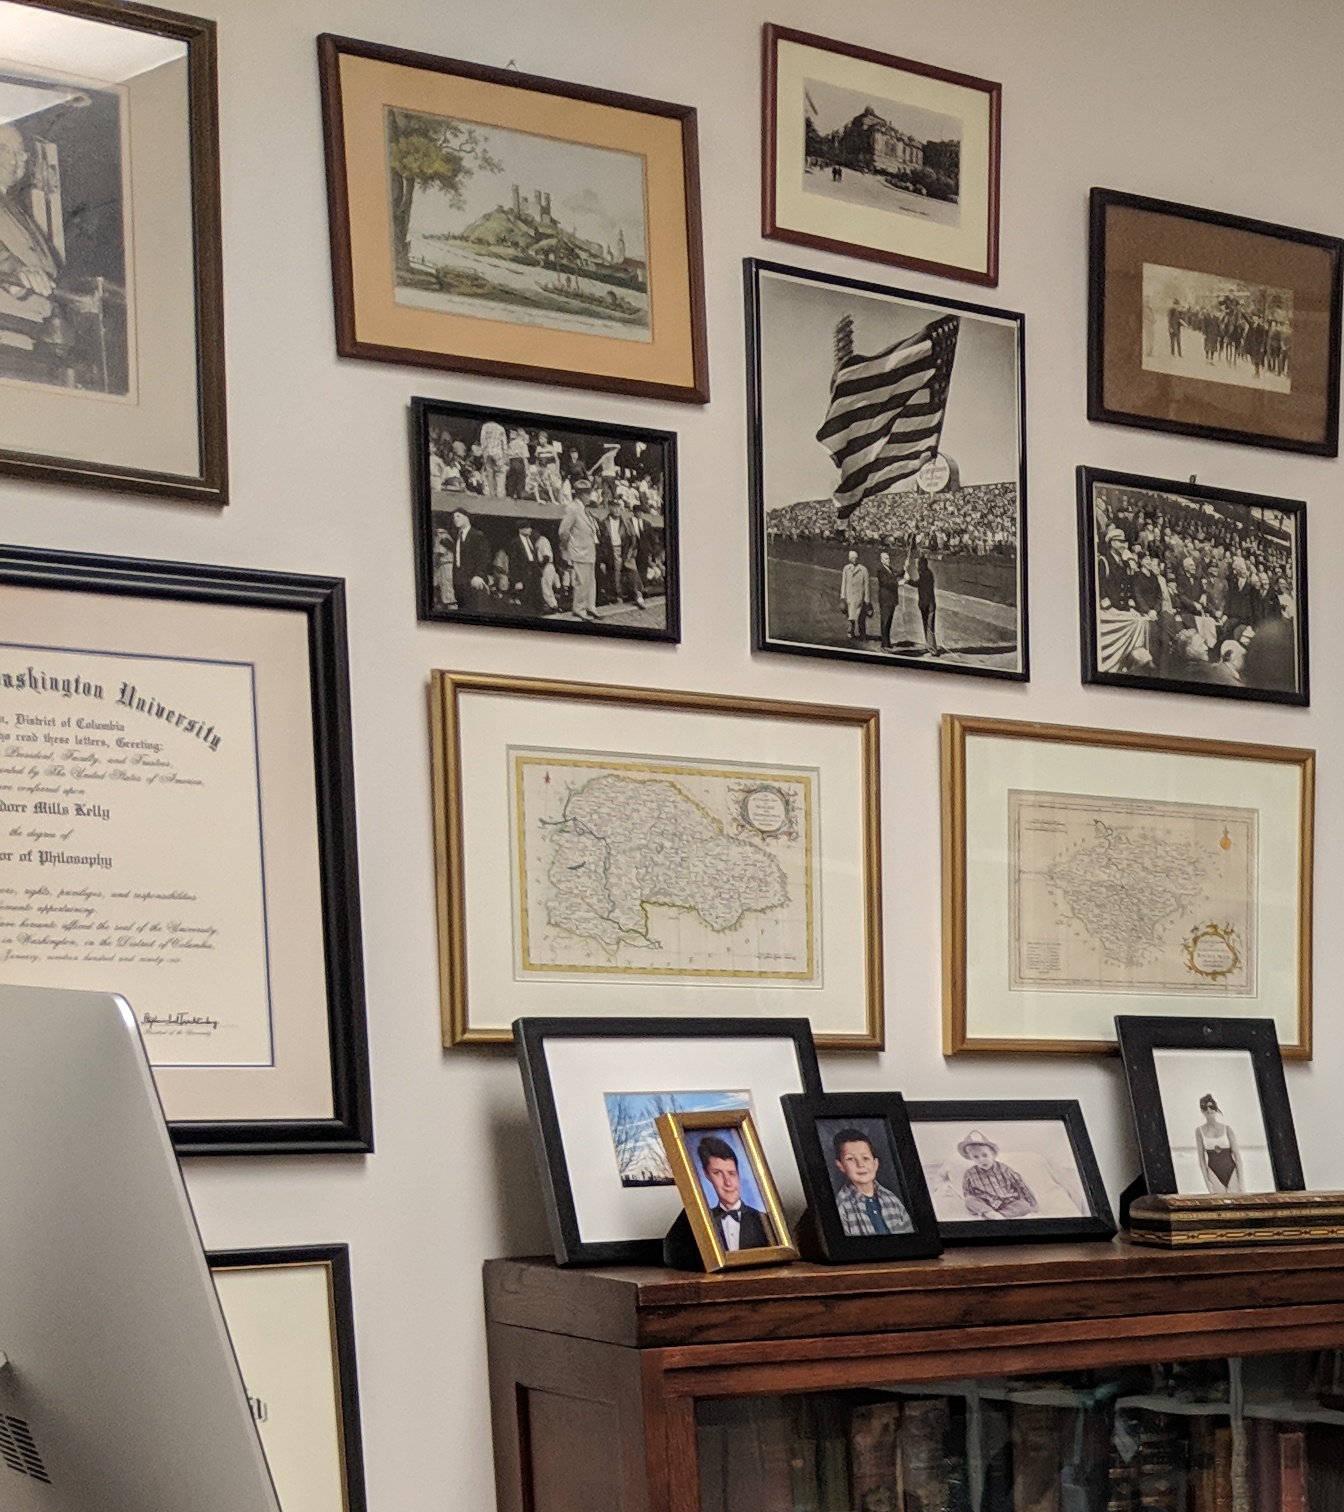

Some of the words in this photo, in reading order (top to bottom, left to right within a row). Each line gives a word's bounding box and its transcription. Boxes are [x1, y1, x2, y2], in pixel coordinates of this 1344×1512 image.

[0, 667, 104, 699] ashington
[116, 681, 222, 752] University
[15, 713, 56, 728] District
[76, 718, 125, 732] Columbia
[33, 802, 69, 816] Mills
[75, 803, 110, 820] Kelly
[39, 851, 112, 869] Philosophy
